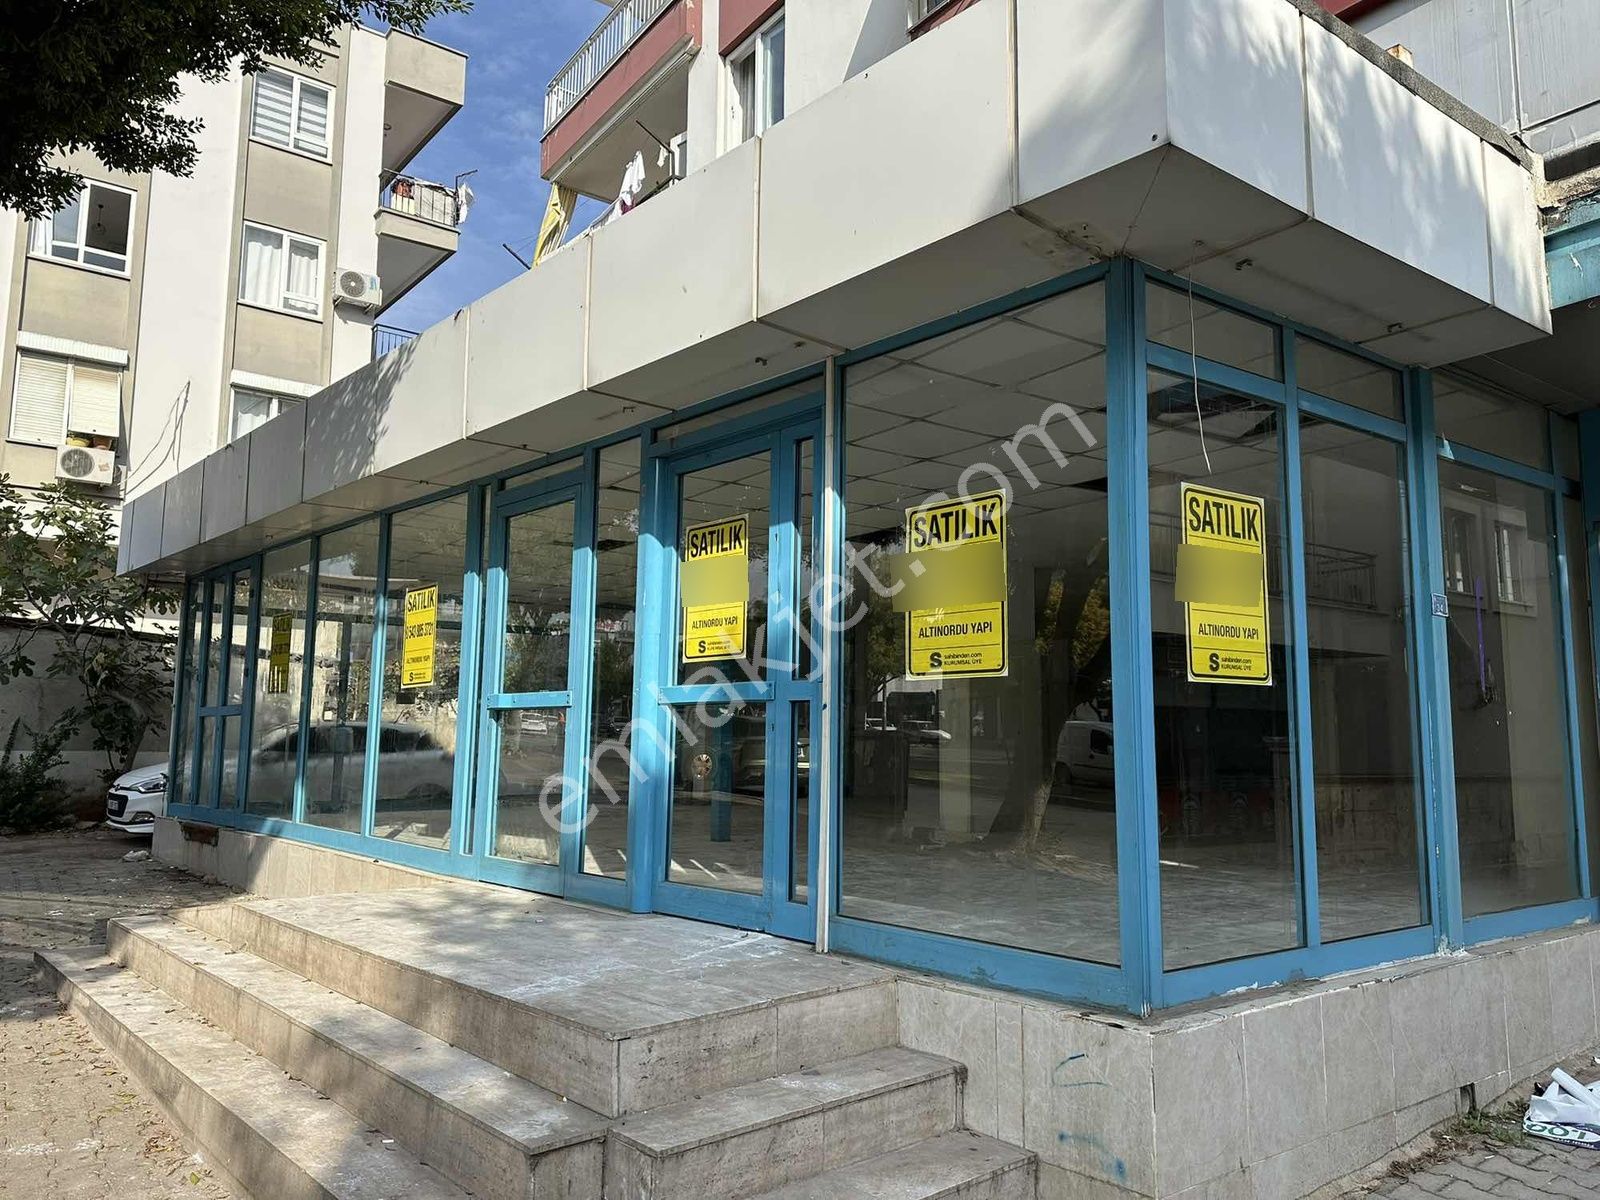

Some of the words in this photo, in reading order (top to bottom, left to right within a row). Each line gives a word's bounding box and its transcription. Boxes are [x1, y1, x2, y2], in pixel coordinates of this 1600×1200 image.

[914, 502, 998, 548] SATILIK
[1189, 496, 1260, 542] SATILIK
[690, 524, 743, 558] SATILIK
[408, 590, 435, 612] SATILIK
[692, 617, 724, 630] ALTINORDU
[724, 615, 738, 627] YAPI
[918, 624, 968, 639] ALTINORDU
[970, 621, 993, 634] YAPI
[1198, 623, 1241, 638] ALTINORDU
[1242, 627, 1259, 640] YAPI
